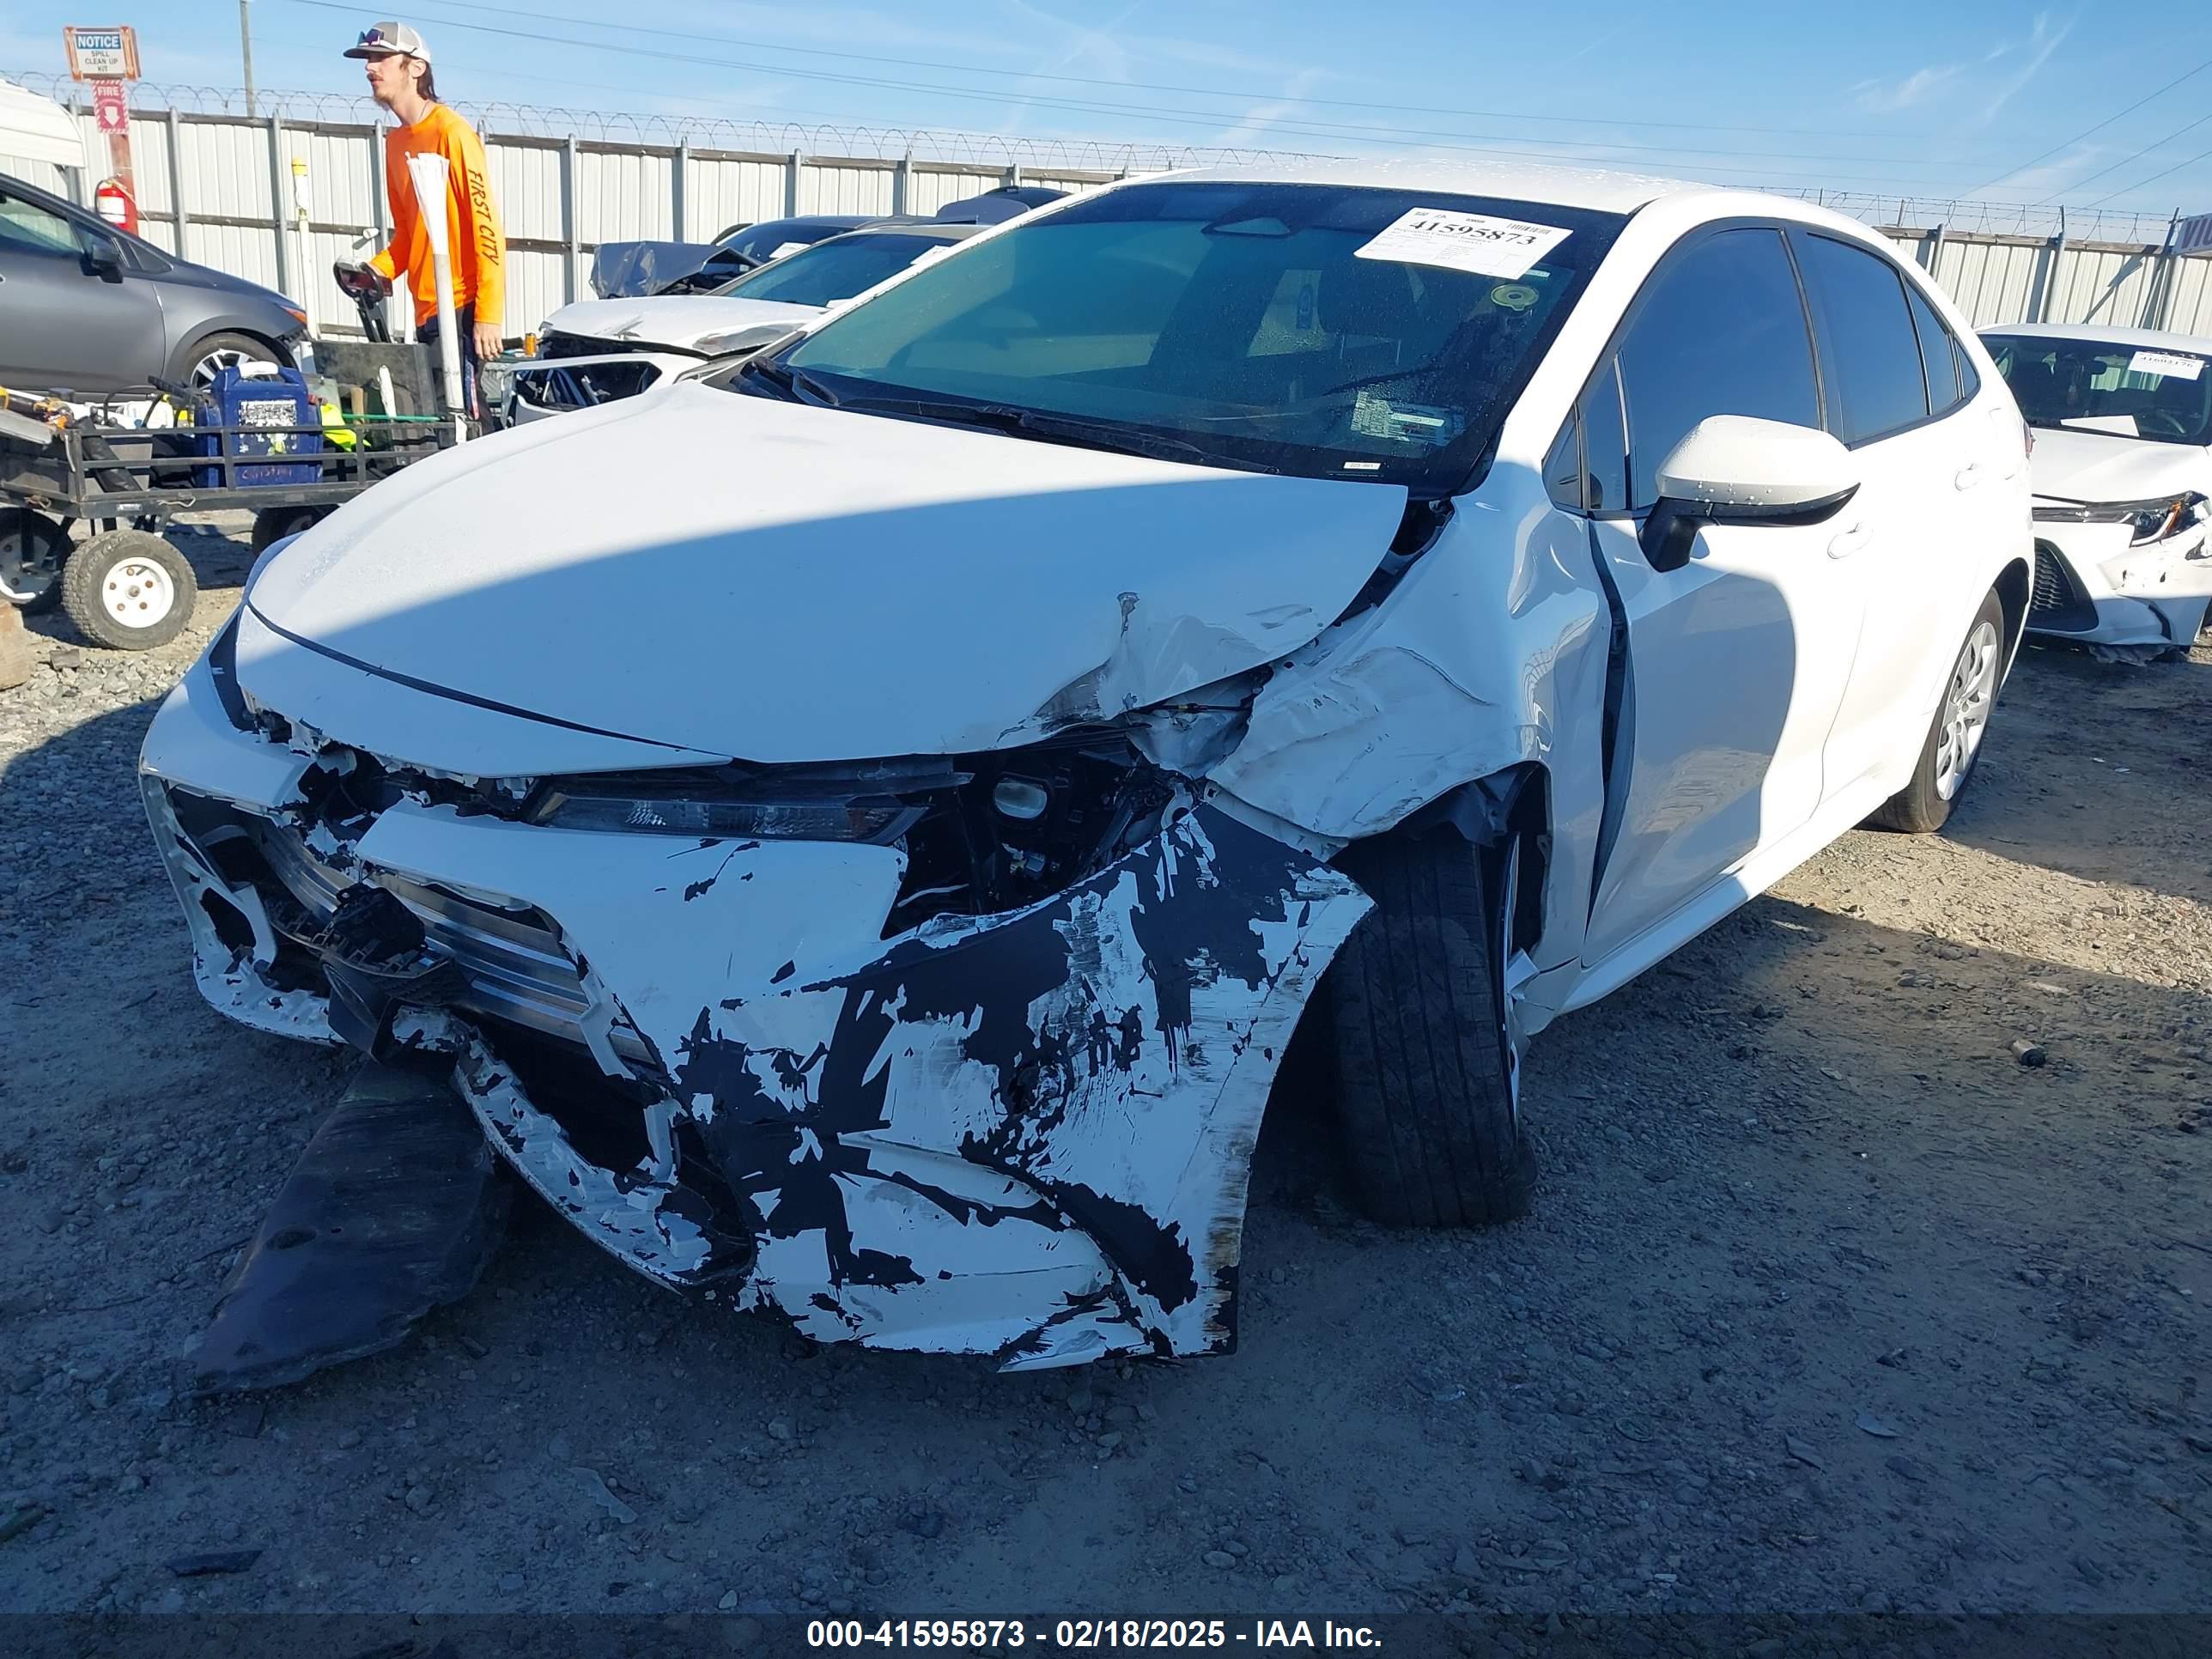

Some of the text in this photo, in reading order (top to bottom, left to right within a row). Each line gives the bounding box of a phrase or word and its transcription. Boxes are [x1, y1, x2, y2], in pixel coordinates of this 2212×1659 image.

[77, 35, 119, 48] NOTICE
[97, 87, 119, 96] FIRE
[468, 169, 499, 265] FIRST CITY
[1409, 220, 1536, 245] 41595873
